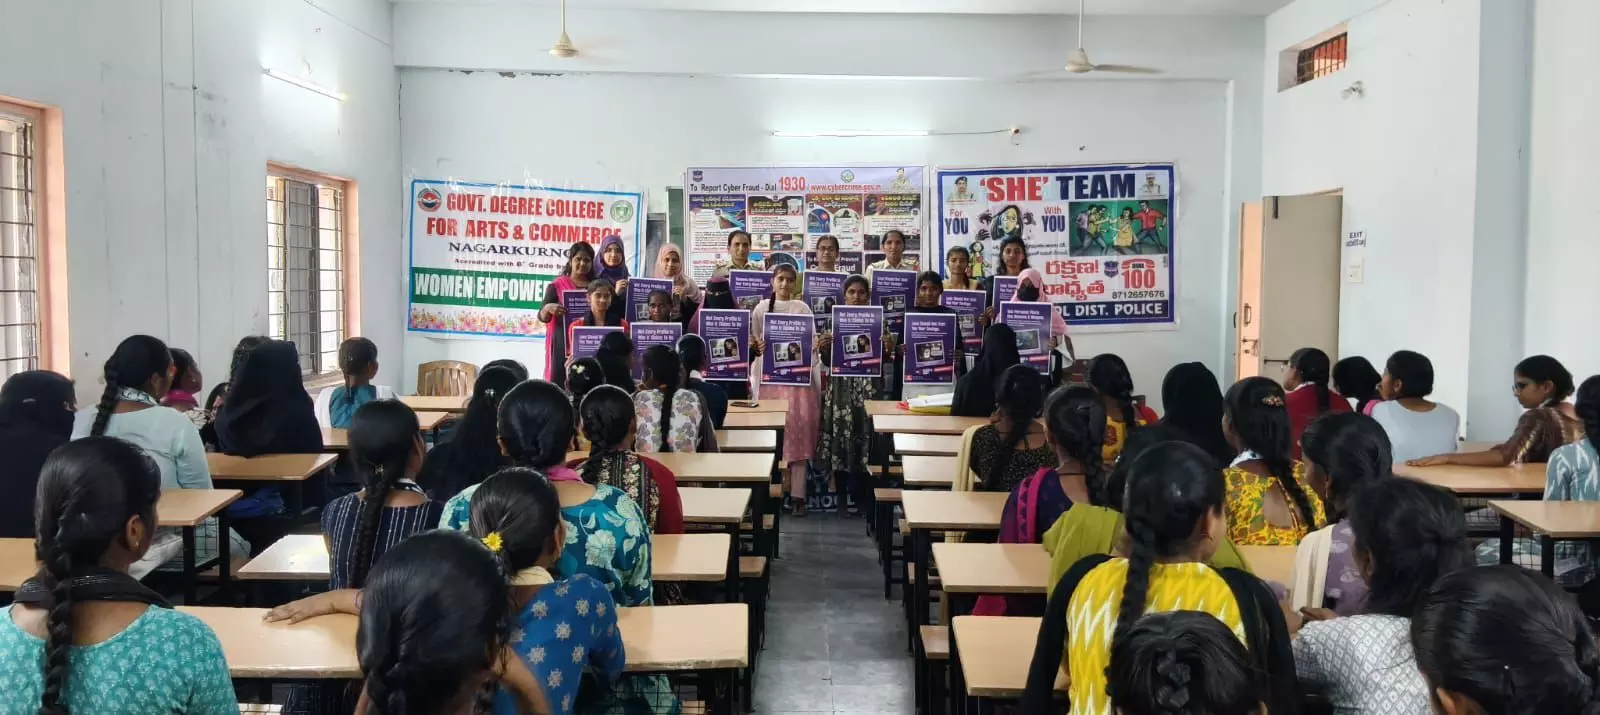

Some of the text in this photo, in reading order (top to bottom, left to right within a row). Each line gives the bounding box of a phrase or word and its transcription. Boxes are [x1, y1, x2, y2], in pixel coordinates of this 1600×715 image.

[702, 184, 722, 192] Report
[723, 184, 740, 193] Cyber
[778, 176, 806, 192] 1930
[1056, 173, 1136, 200] TEAM
[446, 193, 604, 220] GOVT. DEGREE COLLEGE
[1044, 206, 1062, 214] With
[427, 217, 458, 236] FOR
[465, 220, 509, 239] ARTS
[512, 224, 524, 240] &
[944, 218, 968, 234] YOU
[1042, 216, 1066, 232] YOU
[415, 272, 474, 298] WOMEN
[1122, 270, 1156, 289] 100
[1075, 304, 1108, 316] DIST.
[1114, 302, 1163, 316] POLICE
